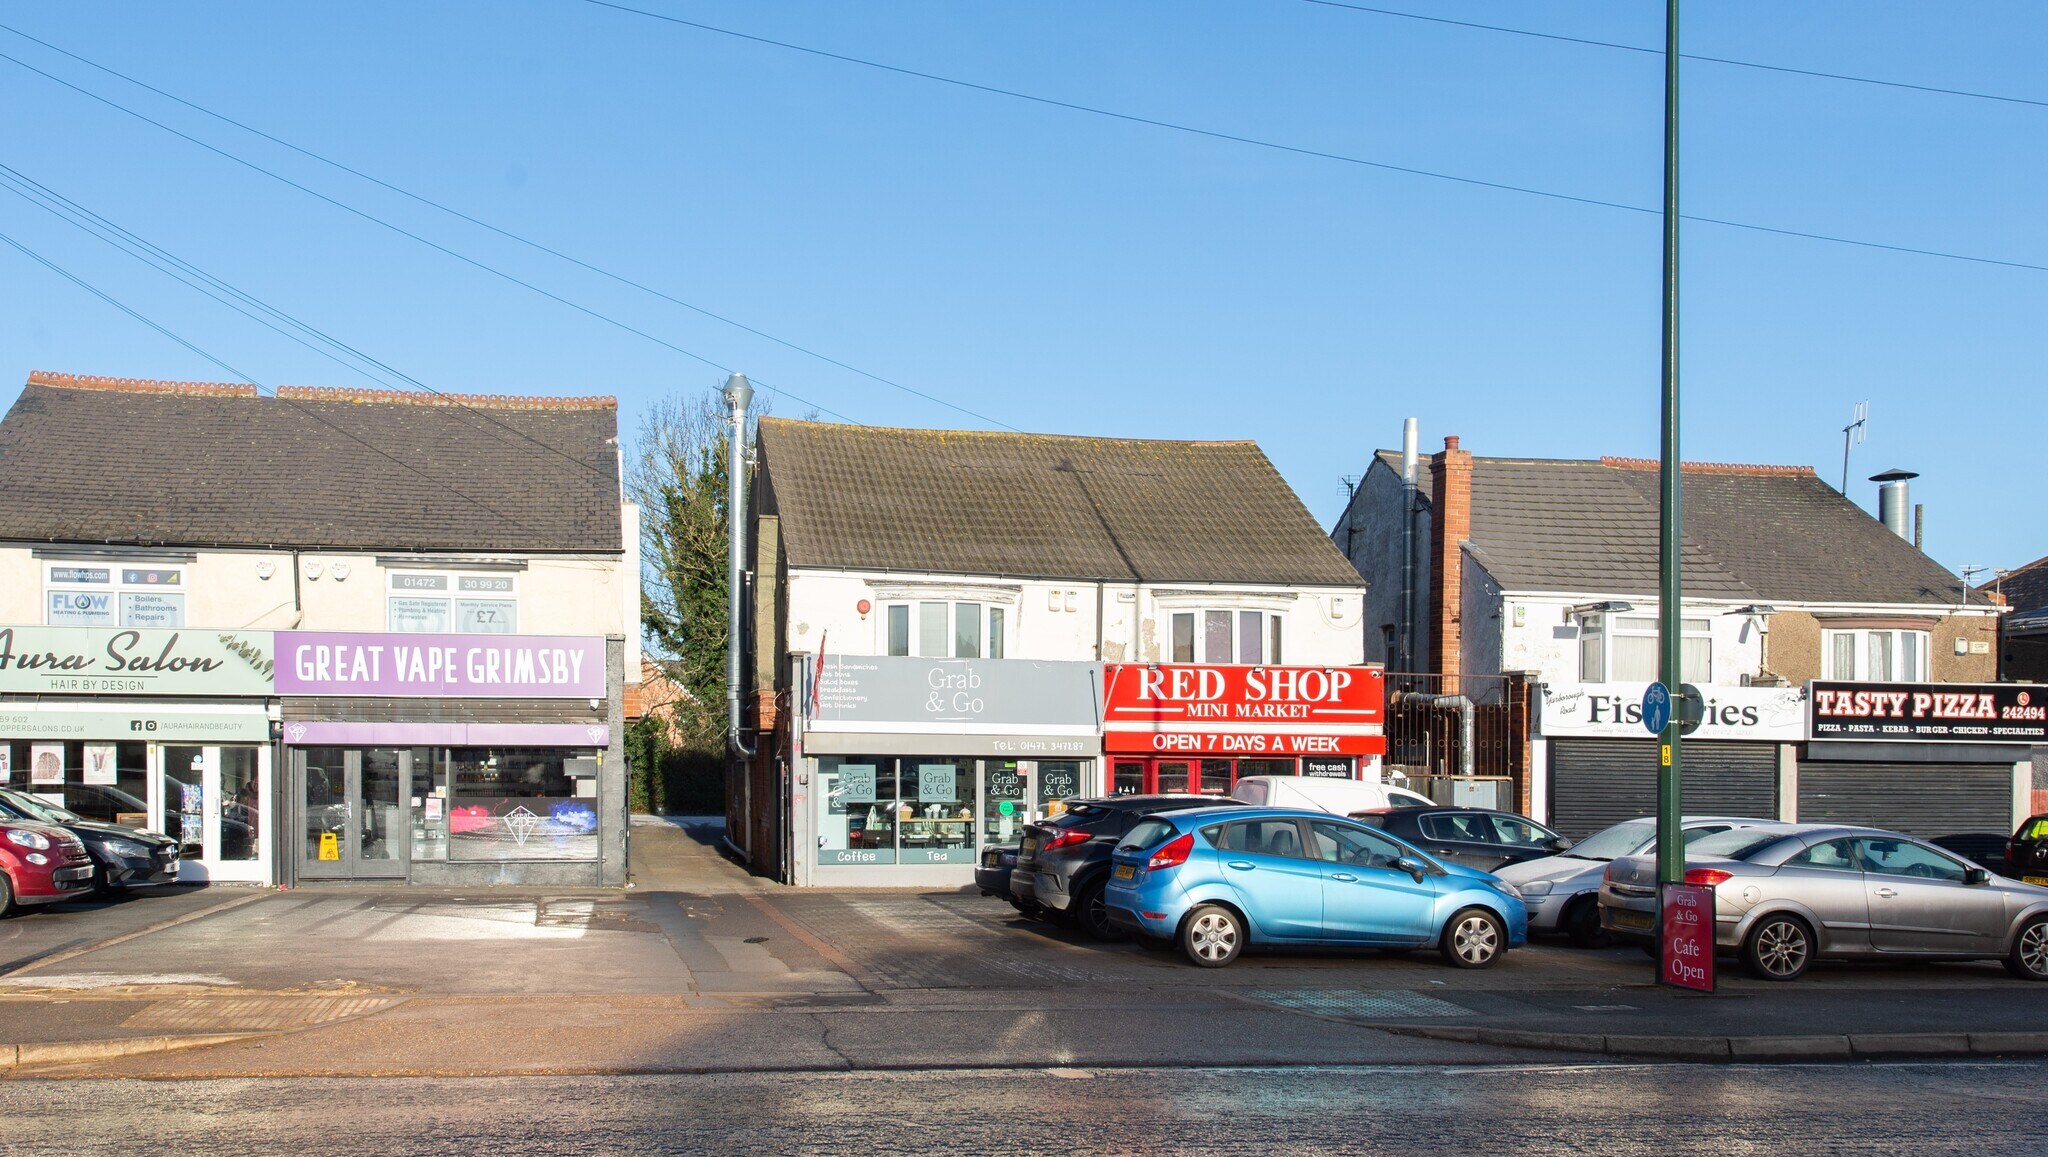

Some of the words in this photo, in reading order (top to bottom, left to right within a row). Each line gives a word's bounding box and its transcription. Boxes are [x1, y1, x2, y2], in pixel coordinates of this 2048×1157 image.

[53, 570, 108, 581] www.flowhps.com
[404, 578, 436, 587] 01472
[465, 580, 477, 589] 30
[480, 580, 492, 589] 99
[495, 581, 507, 590] 20
[135, 613, 165, 621] Repairs
[476, 610, 496, 623] £7
[105, 630, 224, 672] Salon
[295, 645, 384, 682] GREAT
[393, 646, 457, 683] VAPE
[467, 648, 585, 684] GRIMSBY
[928, 667, 981, 690] Grab
[51, 680, 78, 689] HAIR
[83, 680, 97, 690] BY
[102, 680, 144, 691] DESIGN
[1136, 668, 1225, 701] RED
[1245, 668, 1352, 702] SHOP
[925, 692, 945, 713] &
[952, 692, 984, 713] Go
[1816, 690, 1909, 717] TASTY
[1912, 692, 1998, 719] PIZZA
[2002, 706, 2046, 720] 242494
[1187, 703, 1228, 717] MINI
[1235, 704, 1310, 718] MARKET
[1560, 703, 1576, 715] Road
[1818, 724, 1841, 732] PIZZA
[1848, 724, 1875, 732] PASTA
[1882, 725, 1909, 733] KEBAB
[1916, 726, 1949, 734] BURGER
[1952, 727, 1988, 735] CHICKEN
[1993, 727, 2045, 736] SPECIALITIES
[1020, 741, 1047, 751] 01472
[1051, 741, 1084, 751] 347287
[1153, 734, 1201, 751] OPEN
[1207, 735, 1218, 750] 7
[1223, 735, 1265, 751] DAYS
[1271, 736, 1284, 751] A
[1291, 737, 1341, 751] WEEK
[1309, 762, 1326, 771] free
[1327, 763, 1347, 771] cash
[843, 772, 871, 783] Grab
[924, 772, 951, 783] Grab
[992, 773, 1019, 784] Grab
[1045, 773, 1072, 785] Grab
[856, 784, 872, 795] Go
[922, 784, 932, 795] &
[936, 784, 952, 795] Go
[990, 784, 1000, 795] &
[1004, 784, 1020, 795] Go
[1043, 785, 1054, 796] &
[1057, 785, 1073, 796] Go
[837, 851, 876, 862] Coffee
[927, 851, 948, 861] Tea
[1677, 894, 1697, 907] Grab
[1676, 910, 1683, 920] &
[1685, 910, 1698, 922] Go
[1673, 937, 1700, 957] Cafe
[1672, 959, 1705, 981] Open
